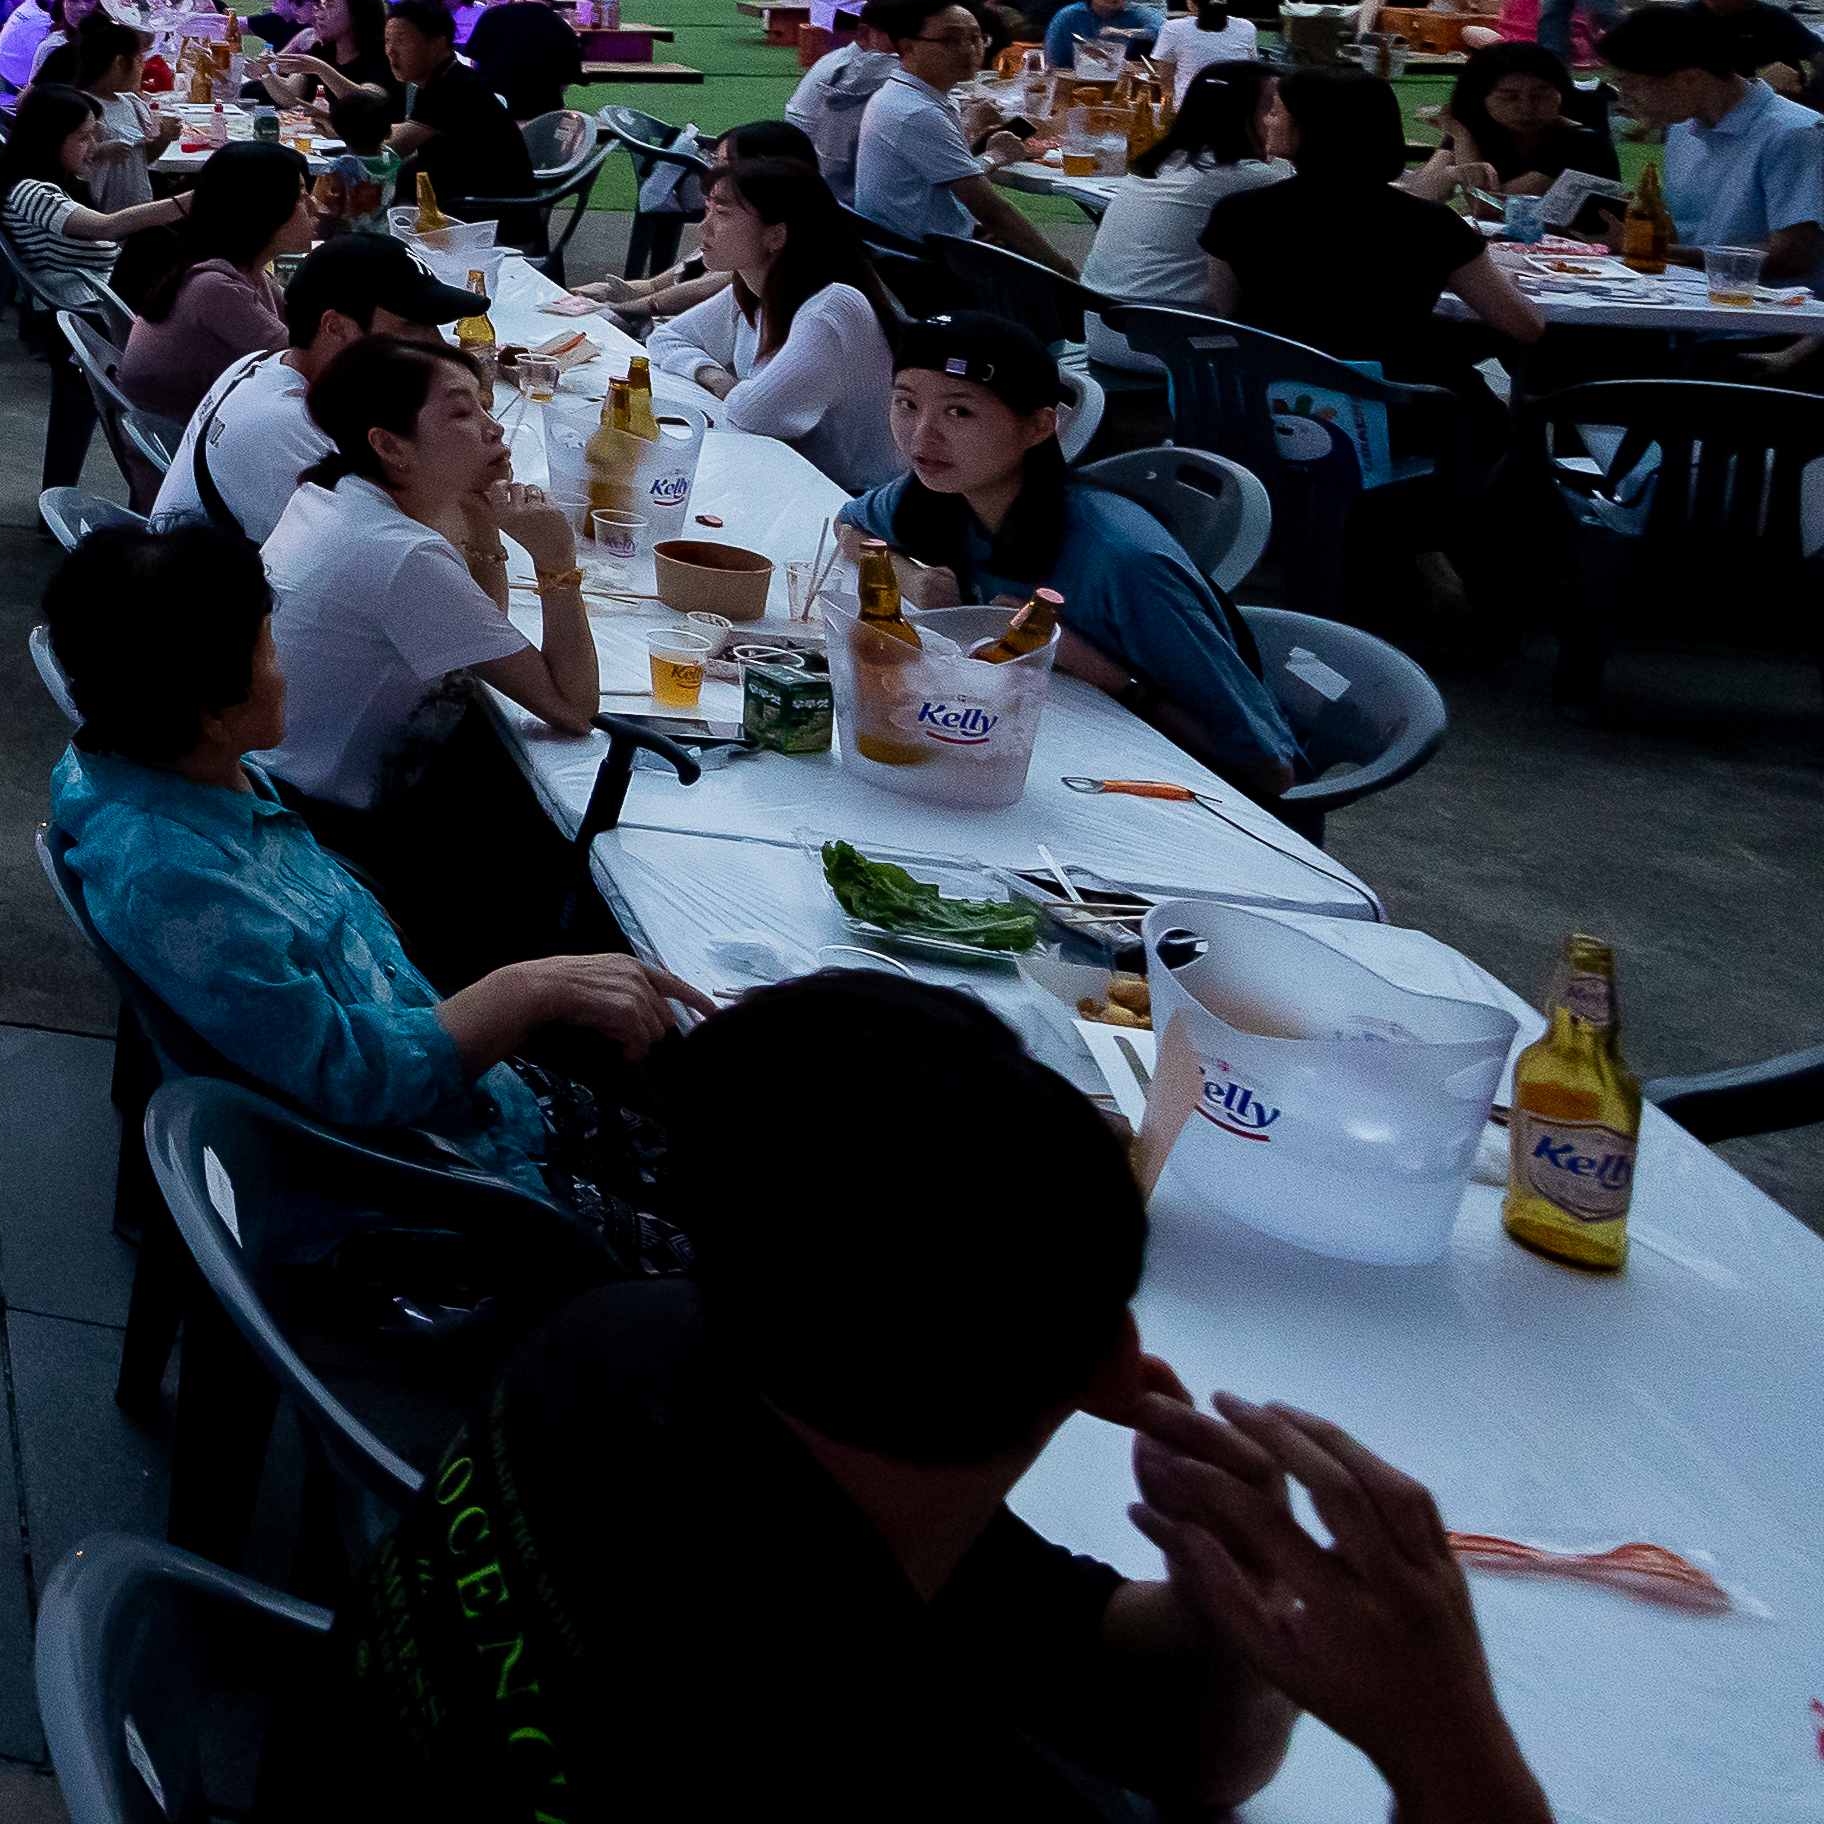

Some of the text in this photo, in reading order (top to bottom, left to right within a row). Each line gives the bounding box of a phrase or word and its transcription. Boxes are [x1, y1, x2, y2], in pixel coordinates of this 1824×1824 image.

[649, 476, 689, 499] Kelly
[917, 700, 998, 735] Kelly
[1200, 1066, 1282, 1130] elly
